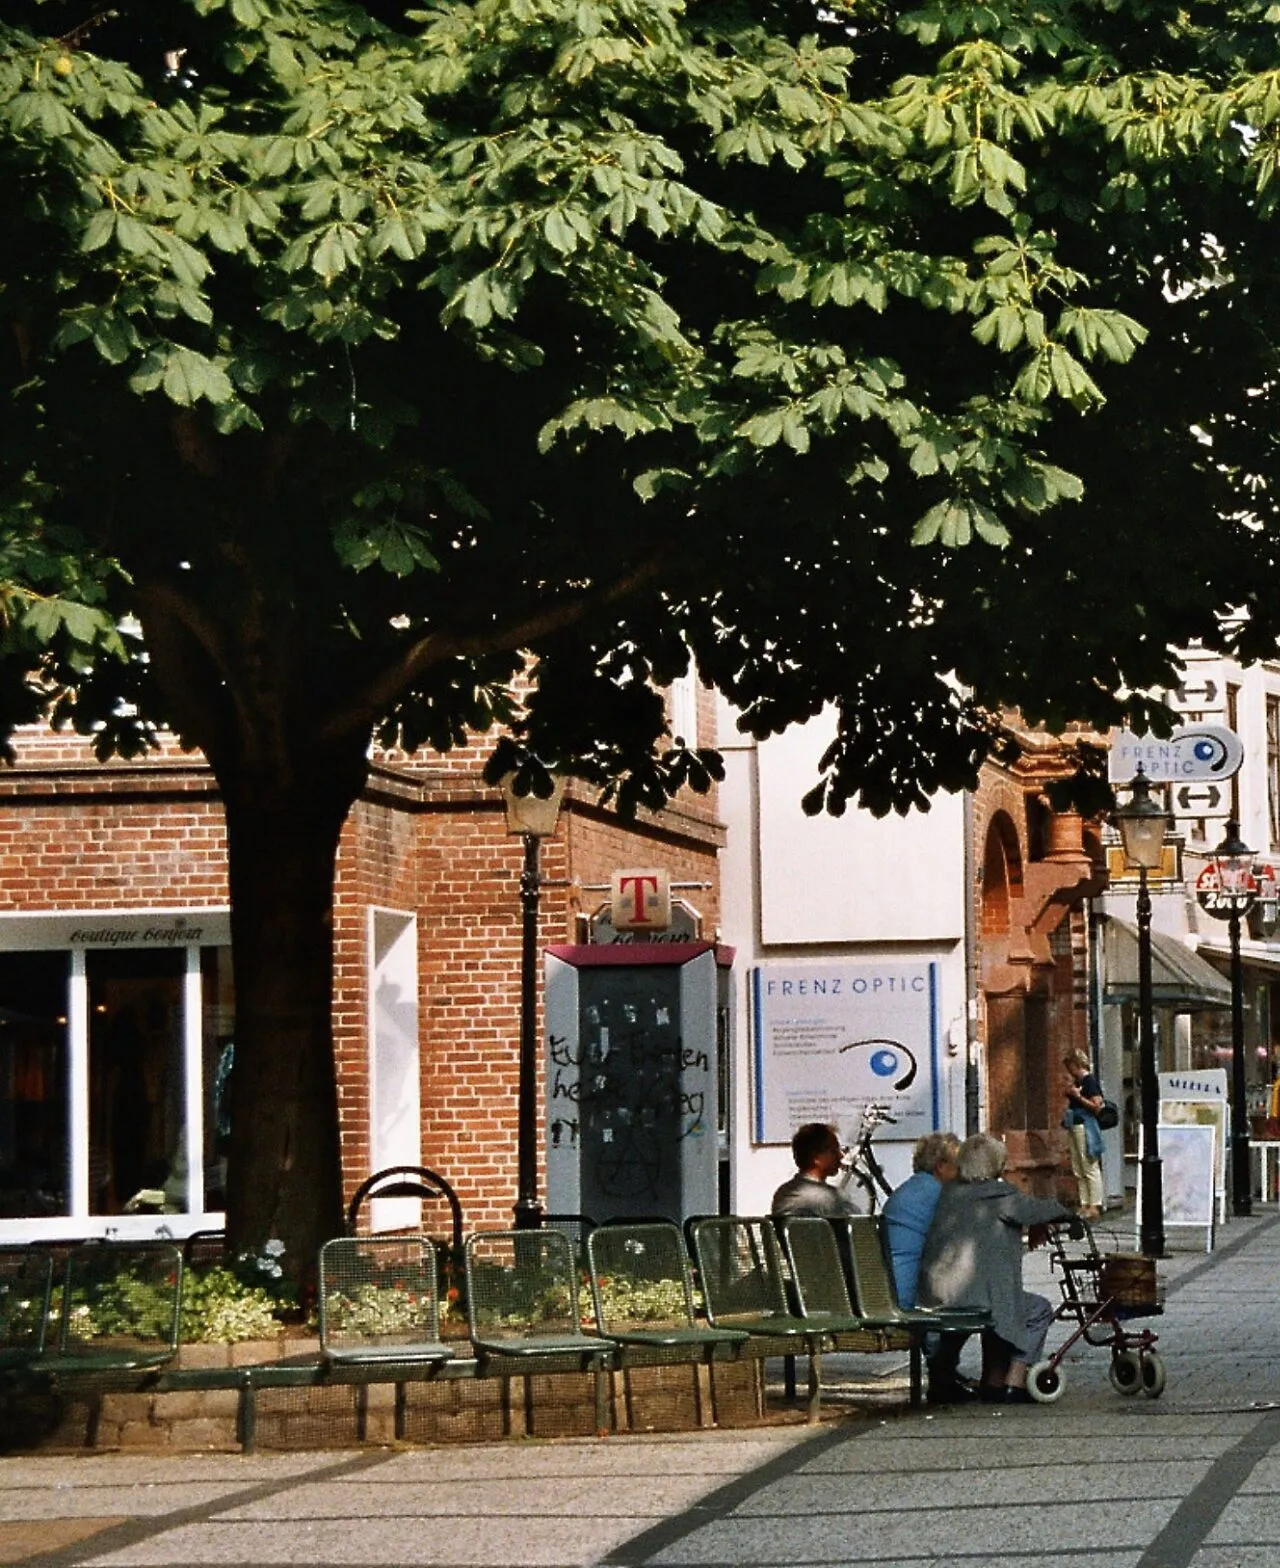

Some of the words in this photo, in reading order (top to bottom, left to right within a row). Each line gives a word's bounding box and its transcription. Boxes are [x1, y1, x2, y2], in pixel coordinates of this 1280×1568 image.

[1122, 746, 1181, 759] FRENZ
[620, 876, 657, 923] T
[69, 928, 138, 946] boutique
[143, 927, 203, 946] bonjour
[767, 979, 842, 996] FRENZ
[852, 976, 925, 994] OPTIC
